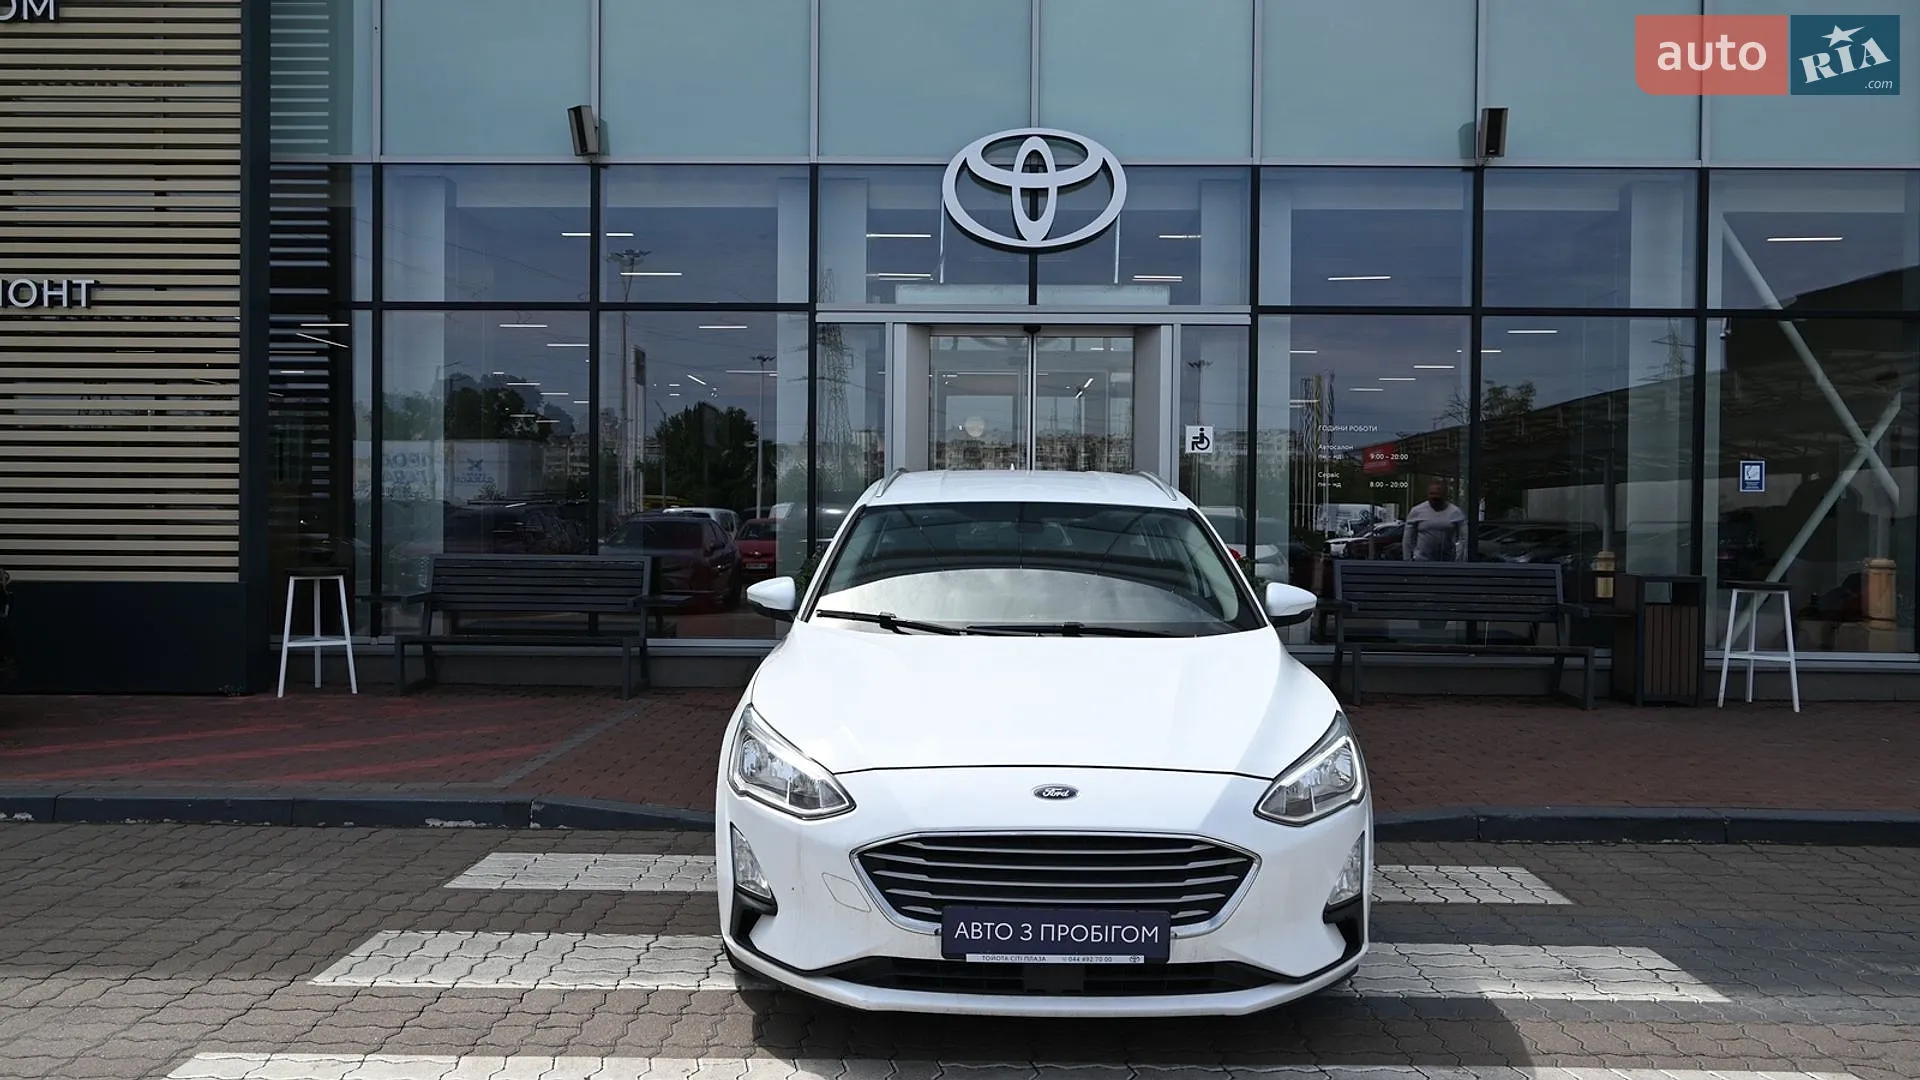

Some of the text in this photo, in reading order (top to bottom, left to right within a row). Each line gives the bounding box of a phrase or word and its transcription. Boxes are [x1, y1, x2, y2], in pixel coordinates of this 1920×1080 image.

[0, 279, 95, 308] ОНТ
[1042, 788, 1070, 797] Ford
[954, 921, 1013, 941] АВТО
[1040, 923, 1159, 943] ПРОБІГОМ
